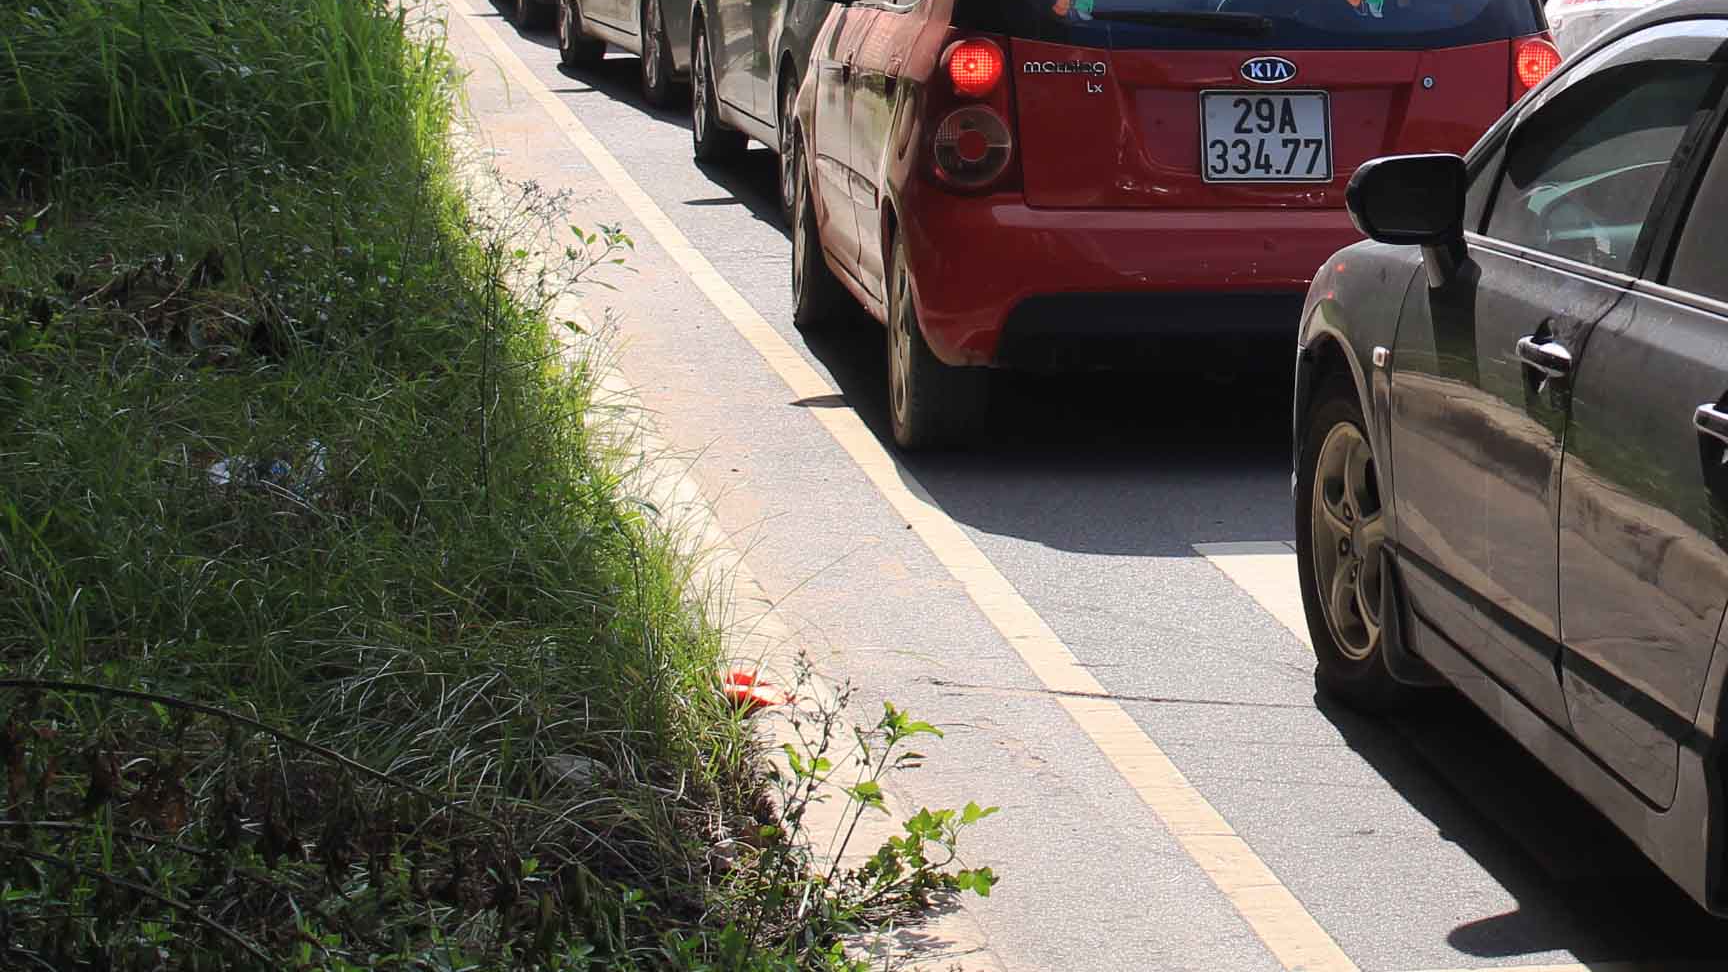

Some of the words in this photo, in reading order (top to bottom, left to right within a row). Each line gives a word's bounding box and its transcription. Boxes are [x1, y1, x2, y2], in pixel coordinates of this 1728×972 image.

[1249, 62, 1288, 78] KIA
[1232, 97, 1298, 134] 29A
[1209, 138, 1323, 175] 334.77
